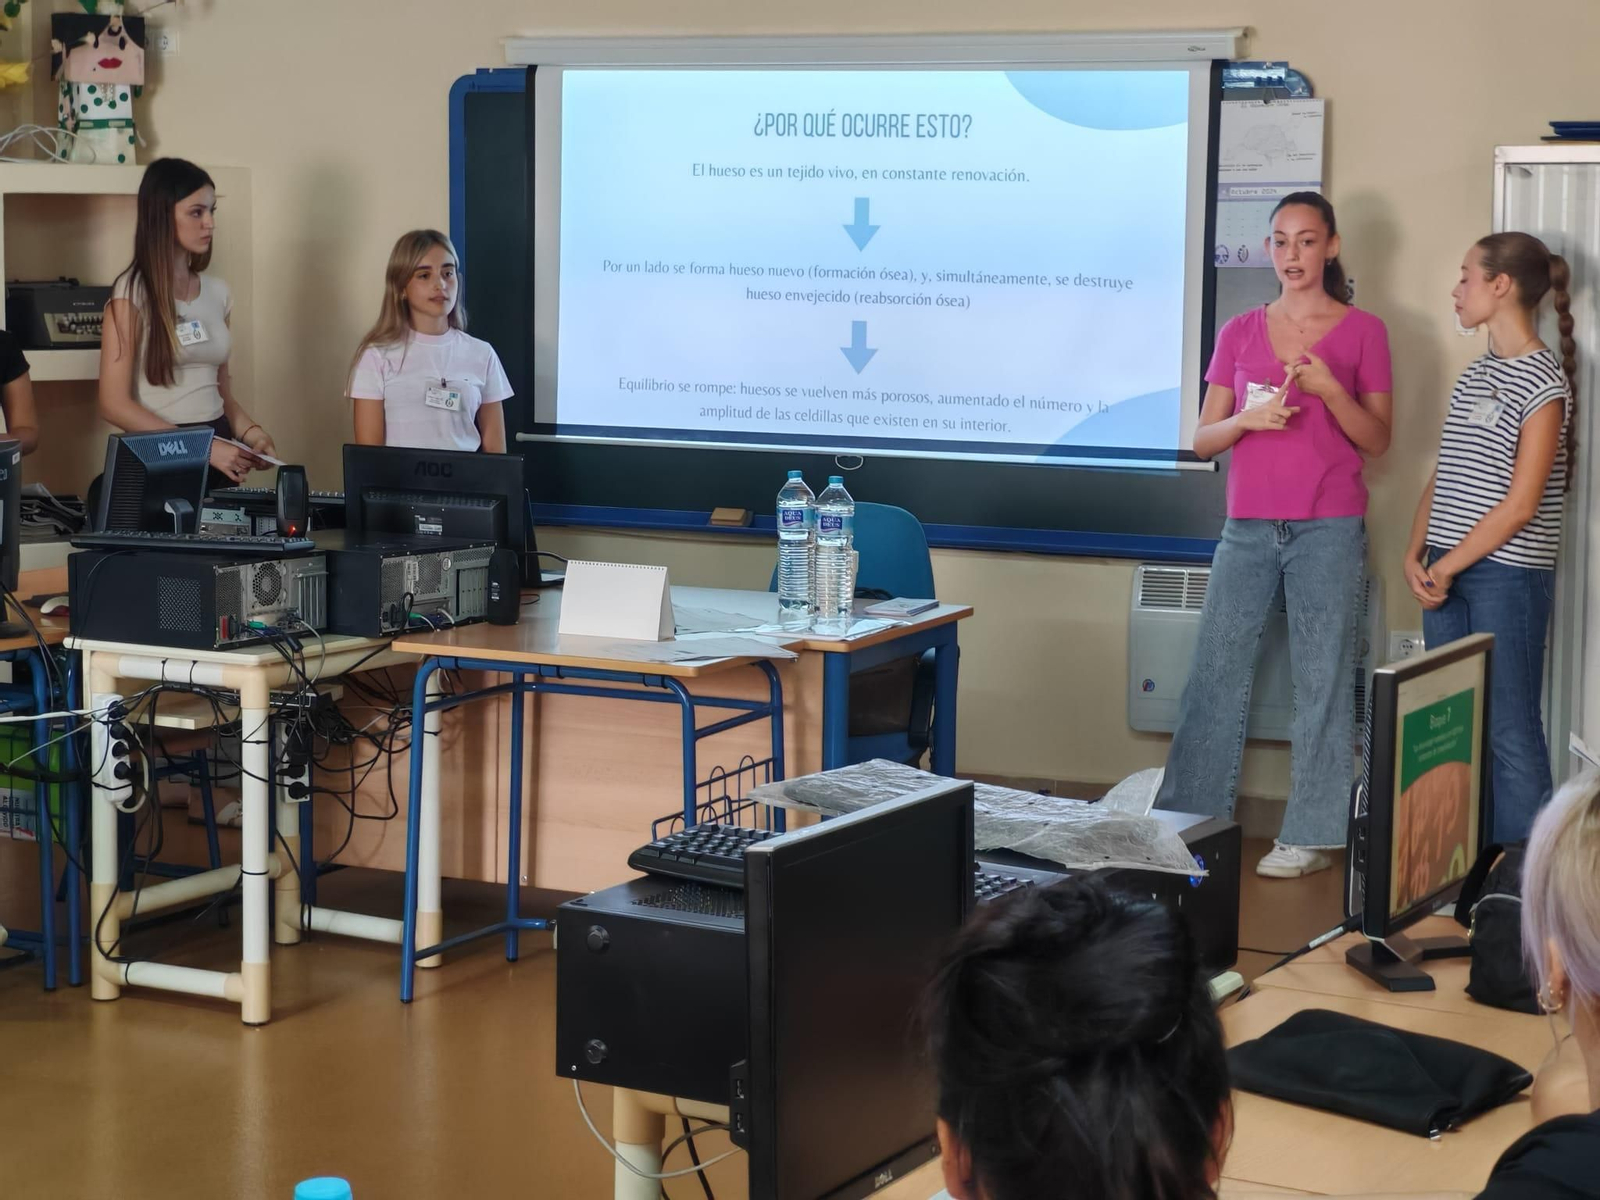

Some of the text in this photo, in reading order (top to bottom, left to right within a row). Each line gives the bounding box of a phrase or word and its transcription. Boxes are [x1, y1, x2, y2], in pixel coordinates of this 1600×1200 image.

[753, 108, 973, 139] ¿POR QUÉ OCURRE ESTO?
[692, 162, 1030, 183] El hueso es un tejido vivo, en constante renovación.
[603, 259, 1134, 293] Por un lado se forma hueso nuevo (formación ósea), y, simultáneamente, se destruye
[746, 286, 971, 310] hueso envejecido (reabsorción ósea)
[618, 376, 1109, 416] Equilibrio se rompe: huesos se vuelven más porosos, aumentado el número y la
[699, 404, 1011, 433] amplitud de las celdillas que existen en su interior.
[157, 440, 188, 456] DELL
[414, 461, 453, 478] AOC
[874, 1169, 893, 1188] DELL
